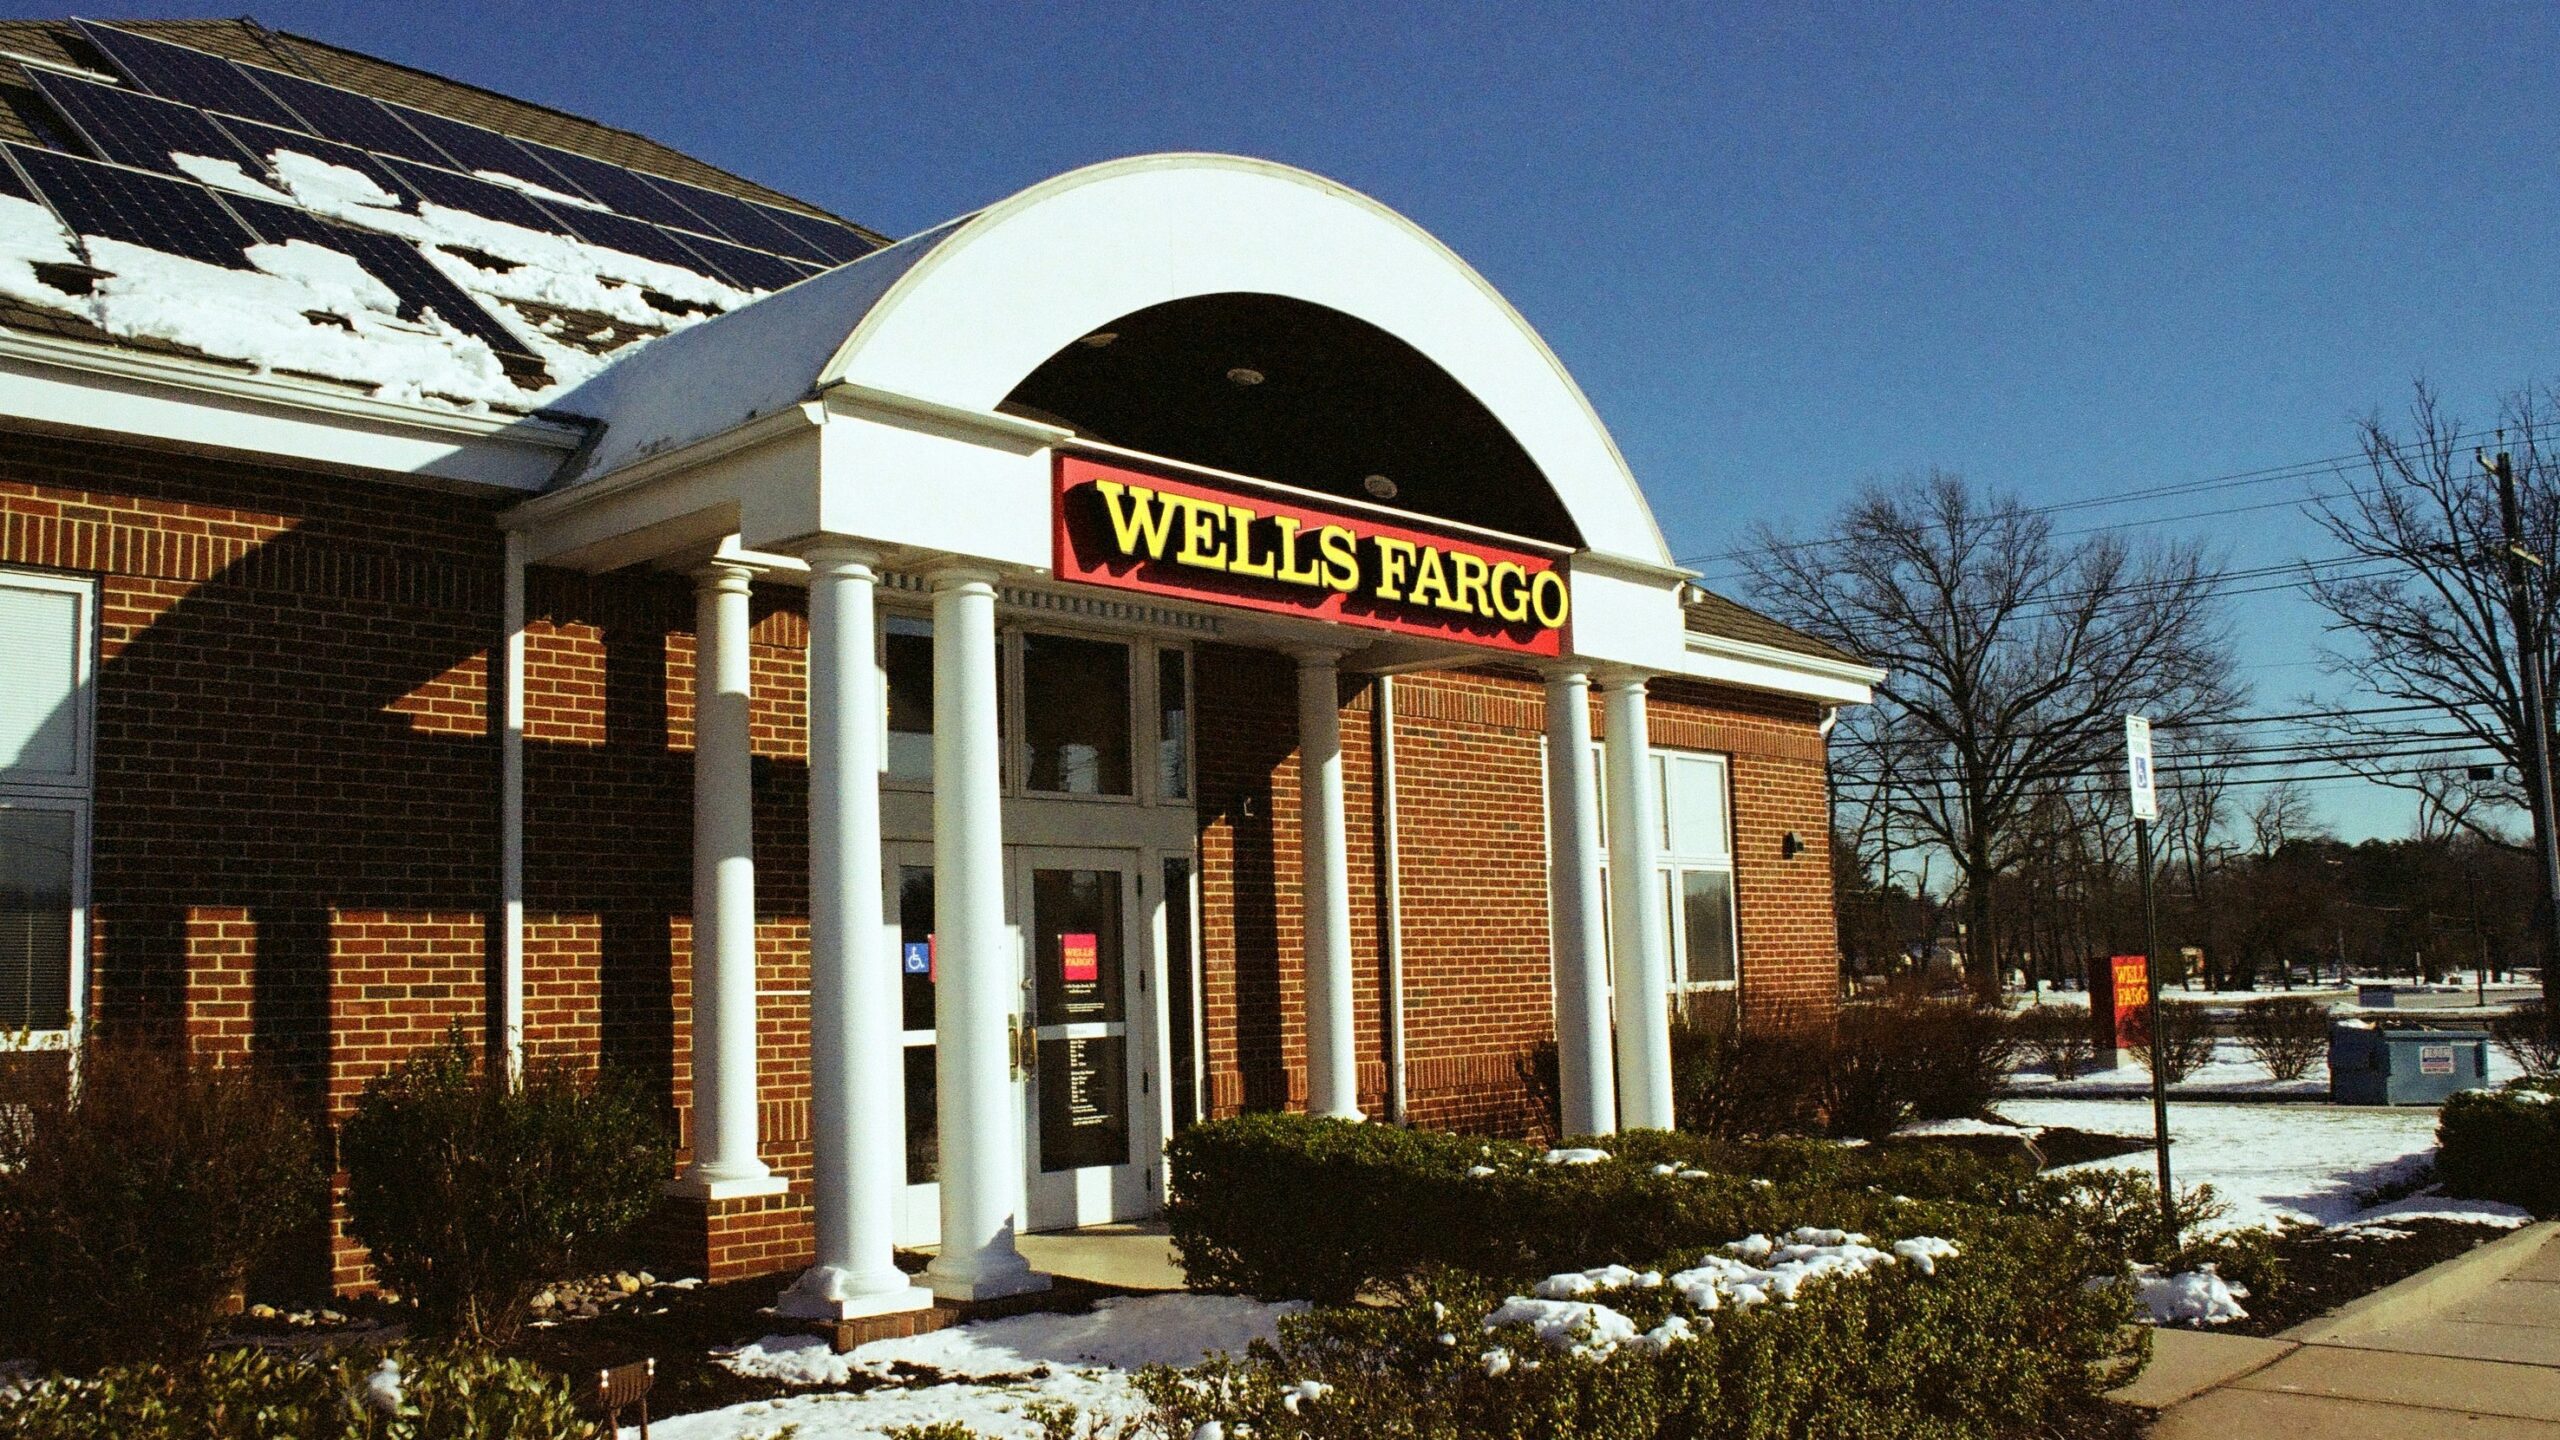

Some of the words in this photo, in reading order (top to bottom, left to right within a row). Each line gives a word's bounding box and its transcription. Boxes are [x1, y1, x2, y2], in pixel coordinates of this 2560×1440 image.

[1096, 479, 1360, 592] WELLS
[1374, 535, 1569, 628] FARGO
[1064, 948, 1094, 957] WELLS
[2115, 965, 2148, 983] WELL
[2117, 986, 2149, 1006] FARG
